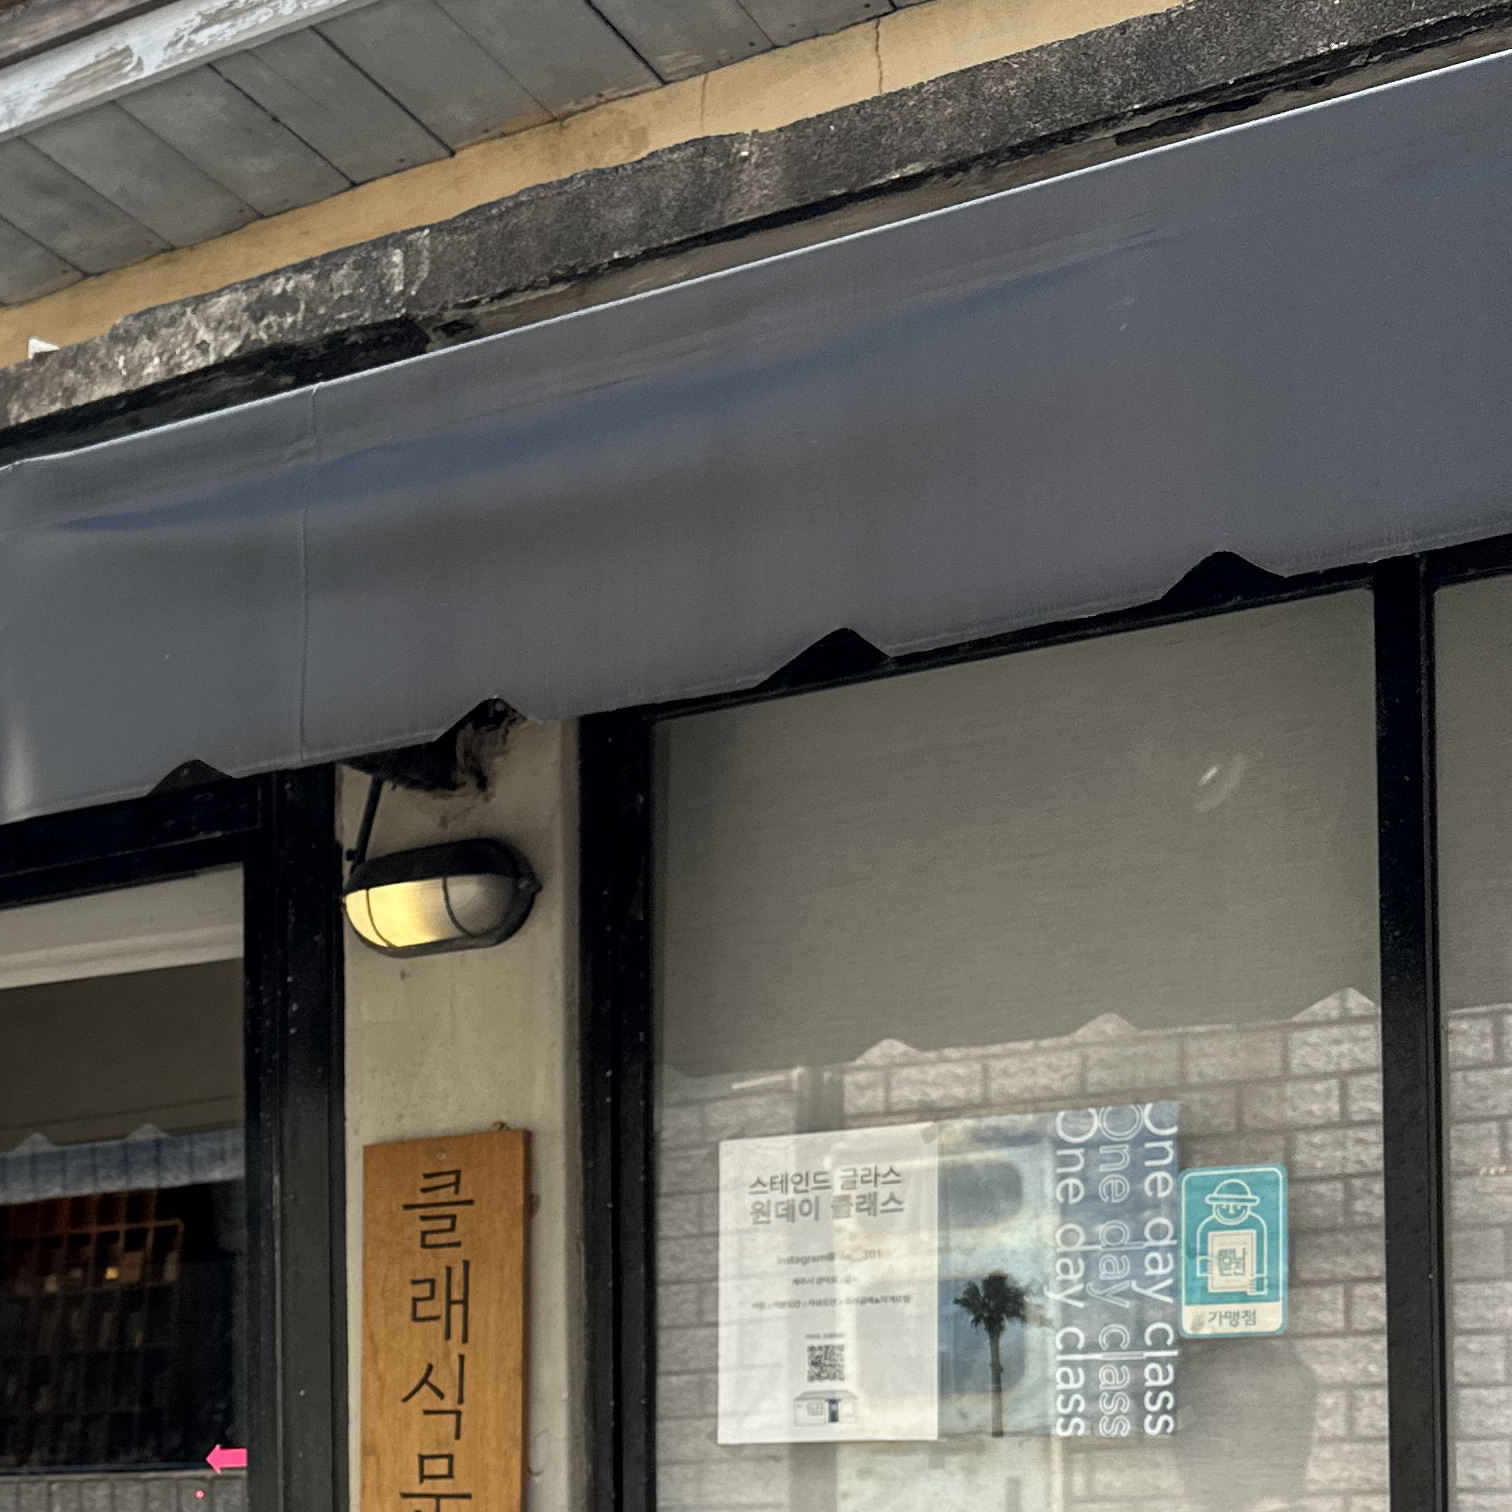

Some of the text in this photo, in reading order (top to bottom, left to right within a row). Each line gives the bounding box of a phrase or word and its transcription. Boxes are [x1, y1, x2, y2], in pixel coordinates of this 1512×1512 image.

[748, 1170, 832, 1195] 스테인드
[749, 1195, 821, 1226] 원데이
[1044, 1108, 1103, 1437] One day class
[1086, 1105, 1147, 1437] One day class
[1131, 1217, 1178, 1304] day
[1207, 1309, 1257, 1328] 가맹점
[1144, 1322, 1179, 1436] class
